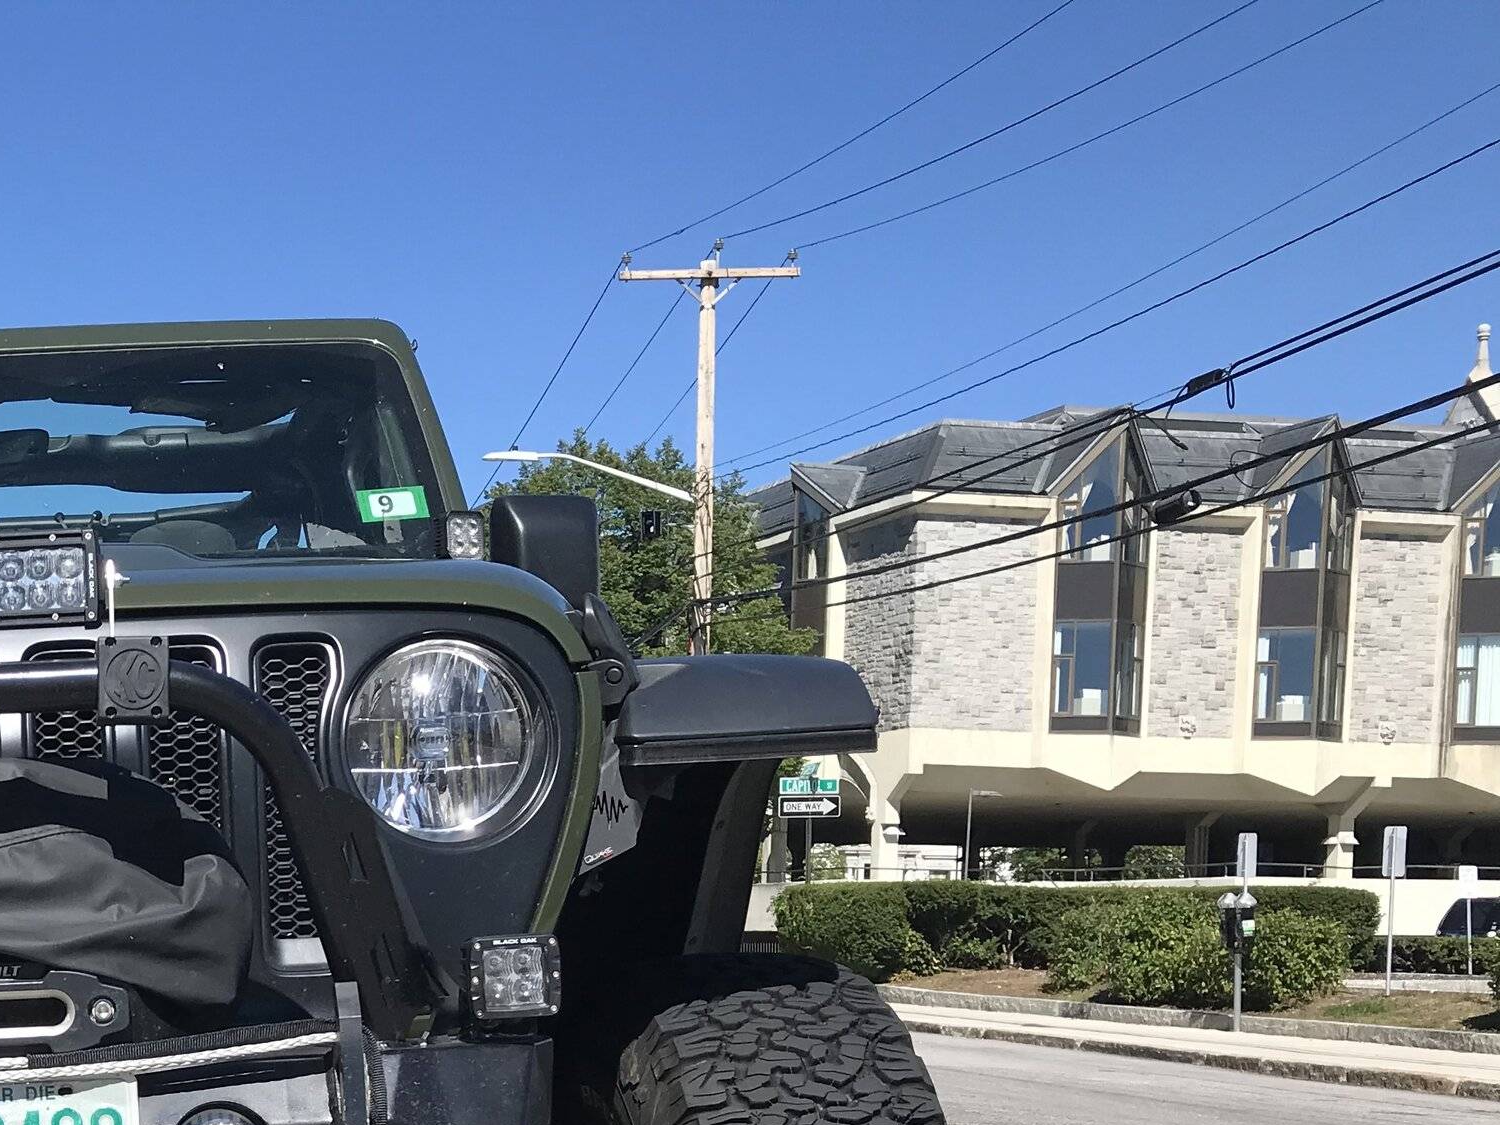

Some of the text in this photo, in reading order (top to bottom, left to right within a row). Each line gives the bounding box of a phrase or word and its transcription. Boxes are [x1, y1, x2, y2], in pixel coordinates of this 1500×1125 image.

[377, 495, 394, 513] 9
[785, 803, 821, 811] ONE WAY
[492, 938, 519, 946] BLACK
[25, 1085, 56, 1101] DIE
